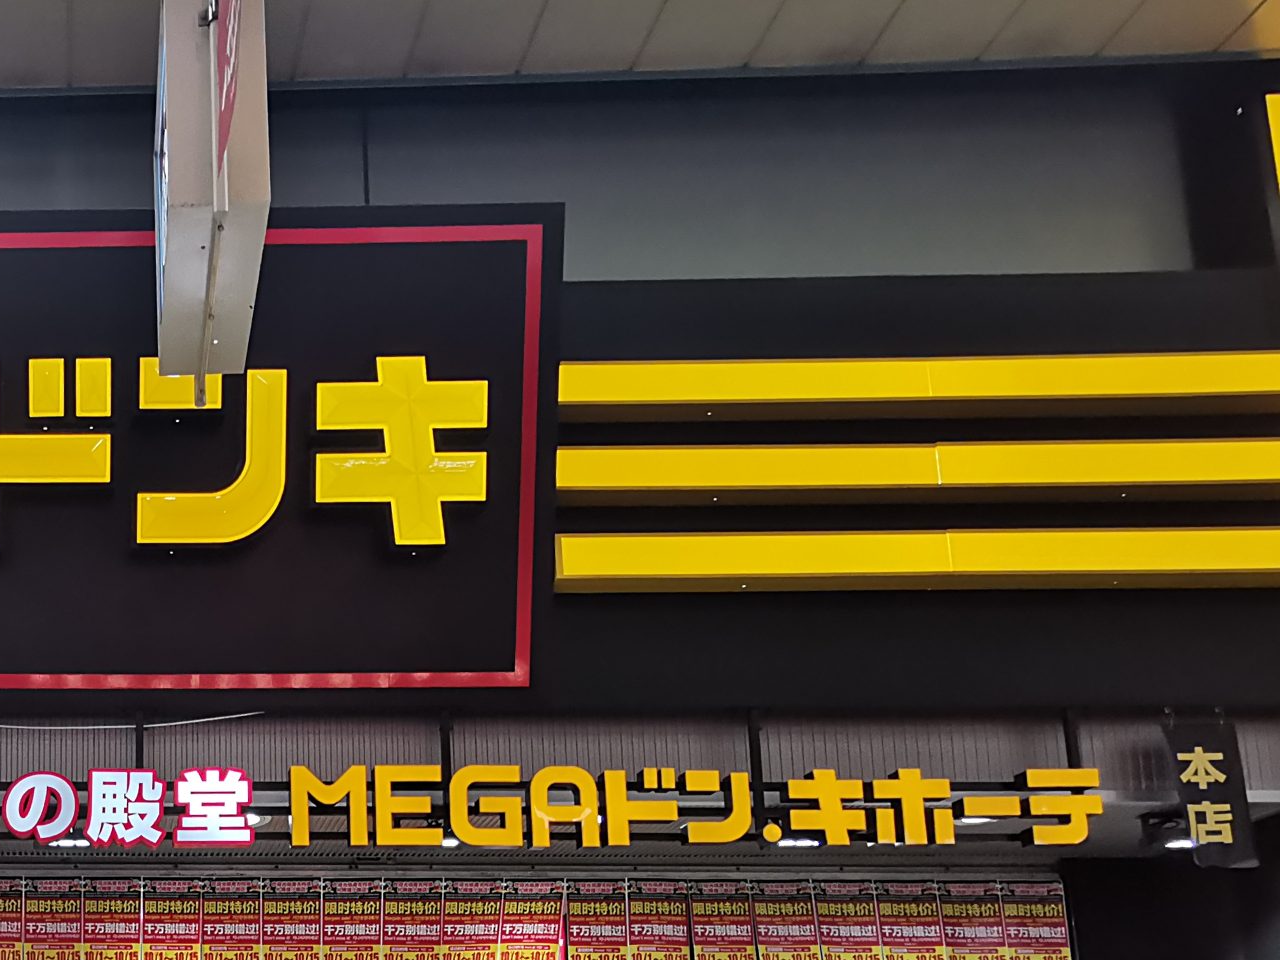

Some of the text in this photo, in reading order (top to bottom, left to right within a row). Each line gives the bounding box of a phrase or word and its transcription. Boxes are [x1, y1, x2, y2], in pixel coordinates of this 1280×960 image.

[1175, 746, 1234, 846] 本店
[26, 900, 80, 914] 限时特价!
[85, 901, 139, 914] 限时特价!
[145, 901, 199, 914] 限时特价!
[204, 901, 258, 914] 限时特价!
[264, 900, 319, 914] 限时特价!
[325, 901, 380, 914] 限时特价!
[384, 900, 440, 914] 限时特价!
[445, 901, 500, 914] 限时特价!
[504, 901, 560, 914] 限时特价!
[570, 902, 625, 915] 限时特价!
[631, 902, 686, 915] 限时特价!
[693, 903, 749, 915] 限时特价!
[755, 903, 811, 915] 限时特价!
[817, 903, 873, 916] 限时特价!
[879, 903, 936, 916] 限时特价!
[943, 904, 999, 916] 限时特价!
[1004, 904, 1062, 916] 限时特价!
